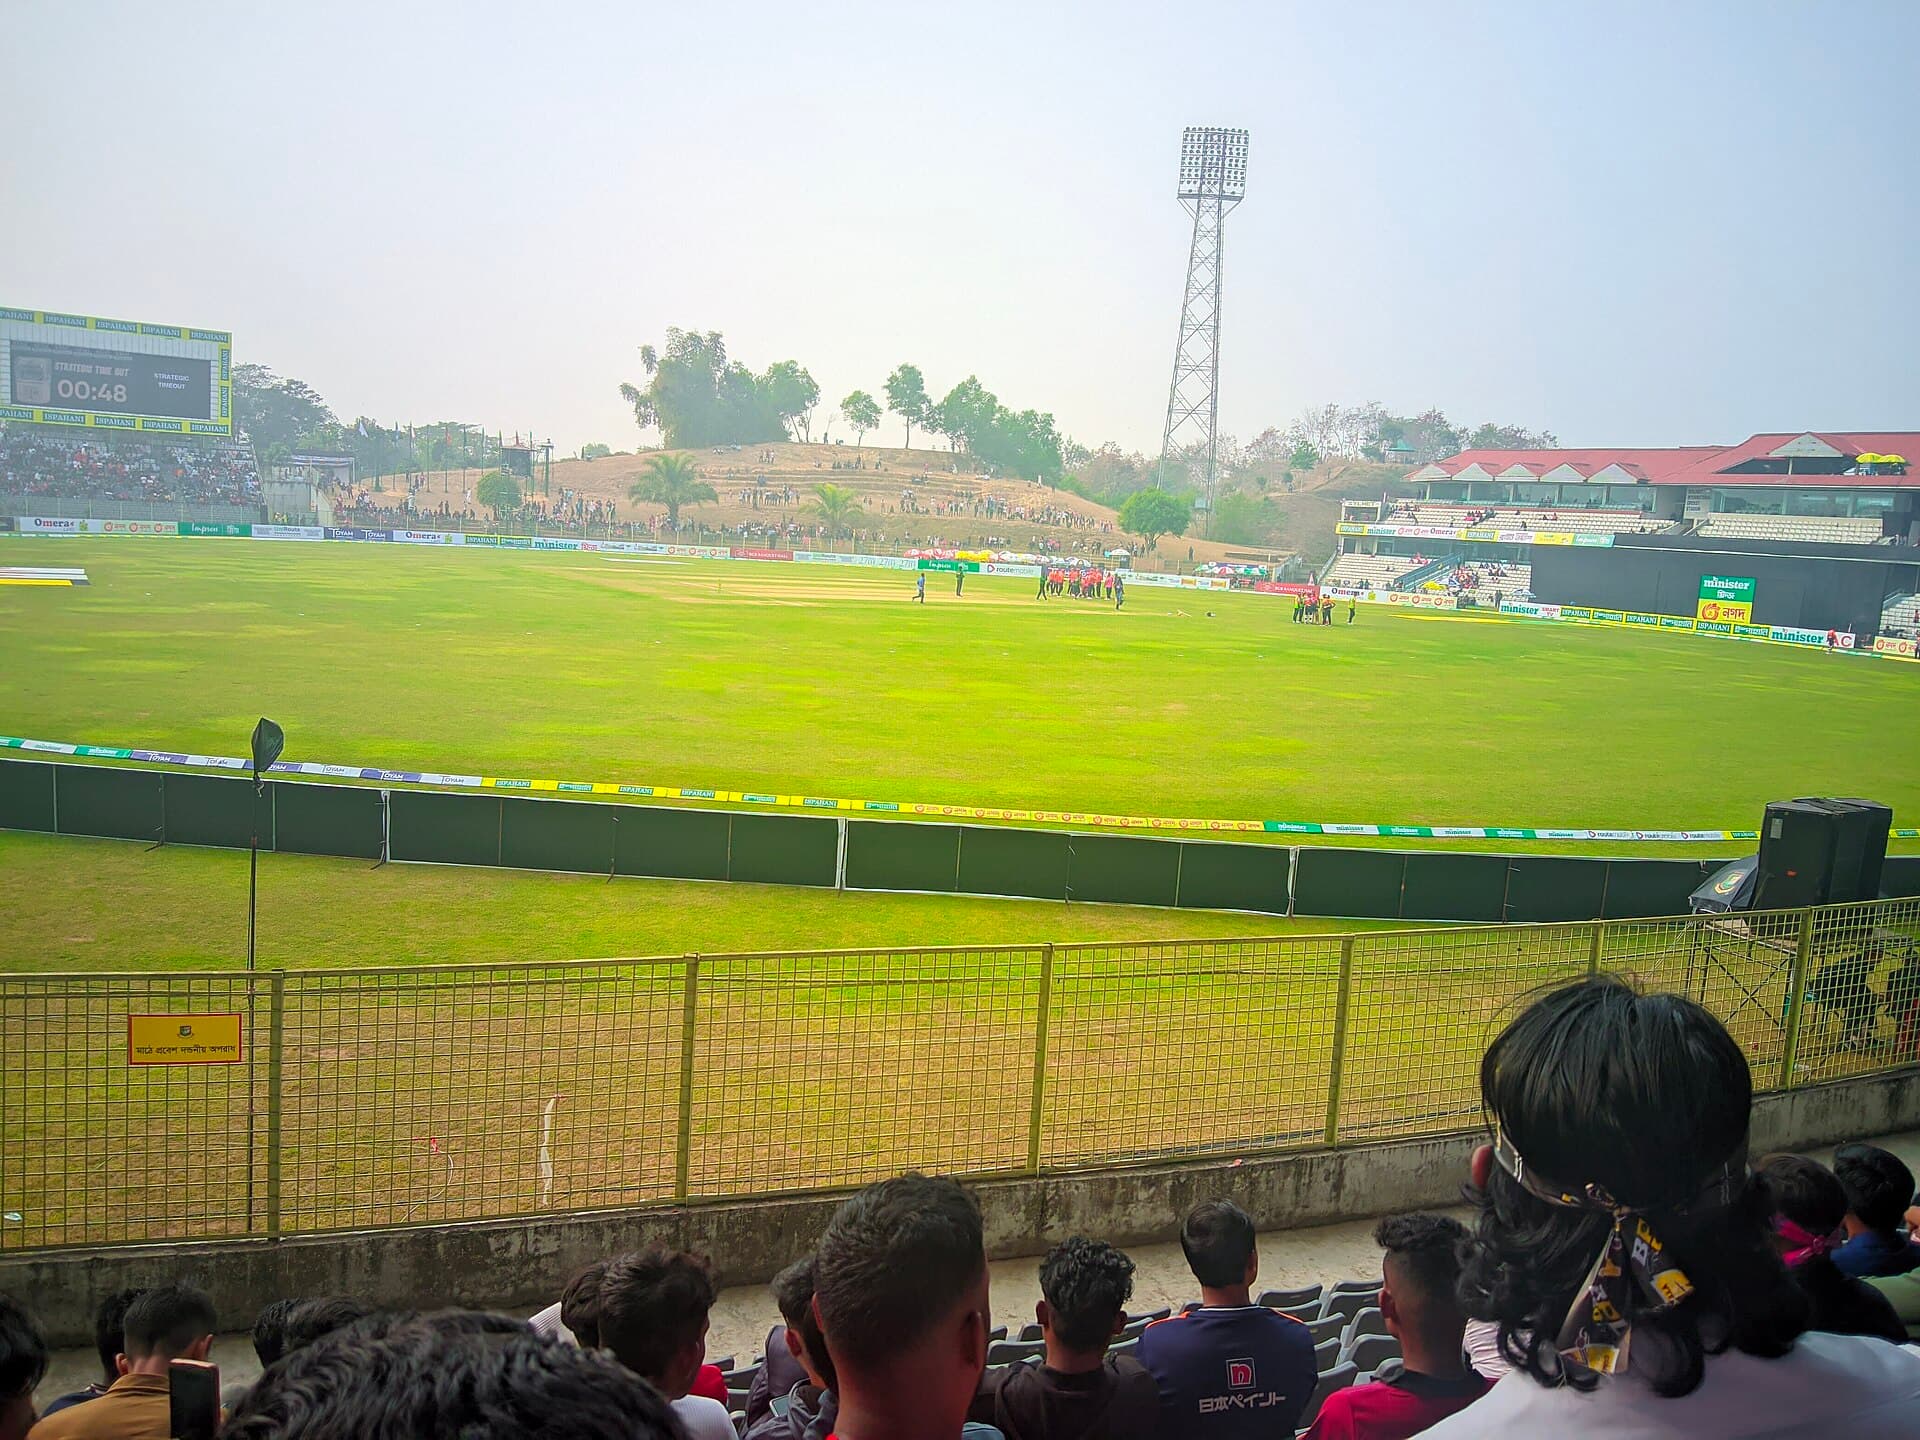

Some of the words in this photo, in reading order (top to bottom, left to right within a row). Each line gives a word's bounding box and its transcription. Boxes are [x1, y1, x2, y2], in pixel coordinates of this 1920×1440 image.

[0, 310, 33, 322] PAHANI
[45, 315, 86, 326] ISPAHANI
[96, 319, 136, 332] ISPAHANI
[143, 326, 180, 337] ISPAHANI
[191, 331, 228, 342] ISPAHANI
[154, 372, 190, 382] STRATEGIC
[57, 379, 127, 403] 00:48
[158, 381, 186, 390] TIMEOUT
[0, 409, 32, 420] PAHANI
[44, 411, 85, 423] ISPAHANI
[95, 416, 135, 428] ISPAHANI
[143, 420, 181, 431] ISPAHANI
[191, 423, 228, 433] ISPAHANI
[34, 518, 70, 528] Omera
[405, 531, 437, 540] Omera
[534, 539, 579, 550] minister
[1704, 576, 1750, 591] minister
[1500, 602, 1540, 615] minister
[1722, 606, 1746, 620] নগদ
[1697, 621, 1731, 633] ISPAHANI
[1772, 629, 1824, 644] minister
[147, 752, 171, 762] TOYAM
[136, 1045, 153, 1055] মাঠে
[155, 1046, 178, 1055] প্রবেশ
[209, 1045, 236, 1054] অপরাধ
[1199, 1391, 1286, 1413] 日本ペイント
